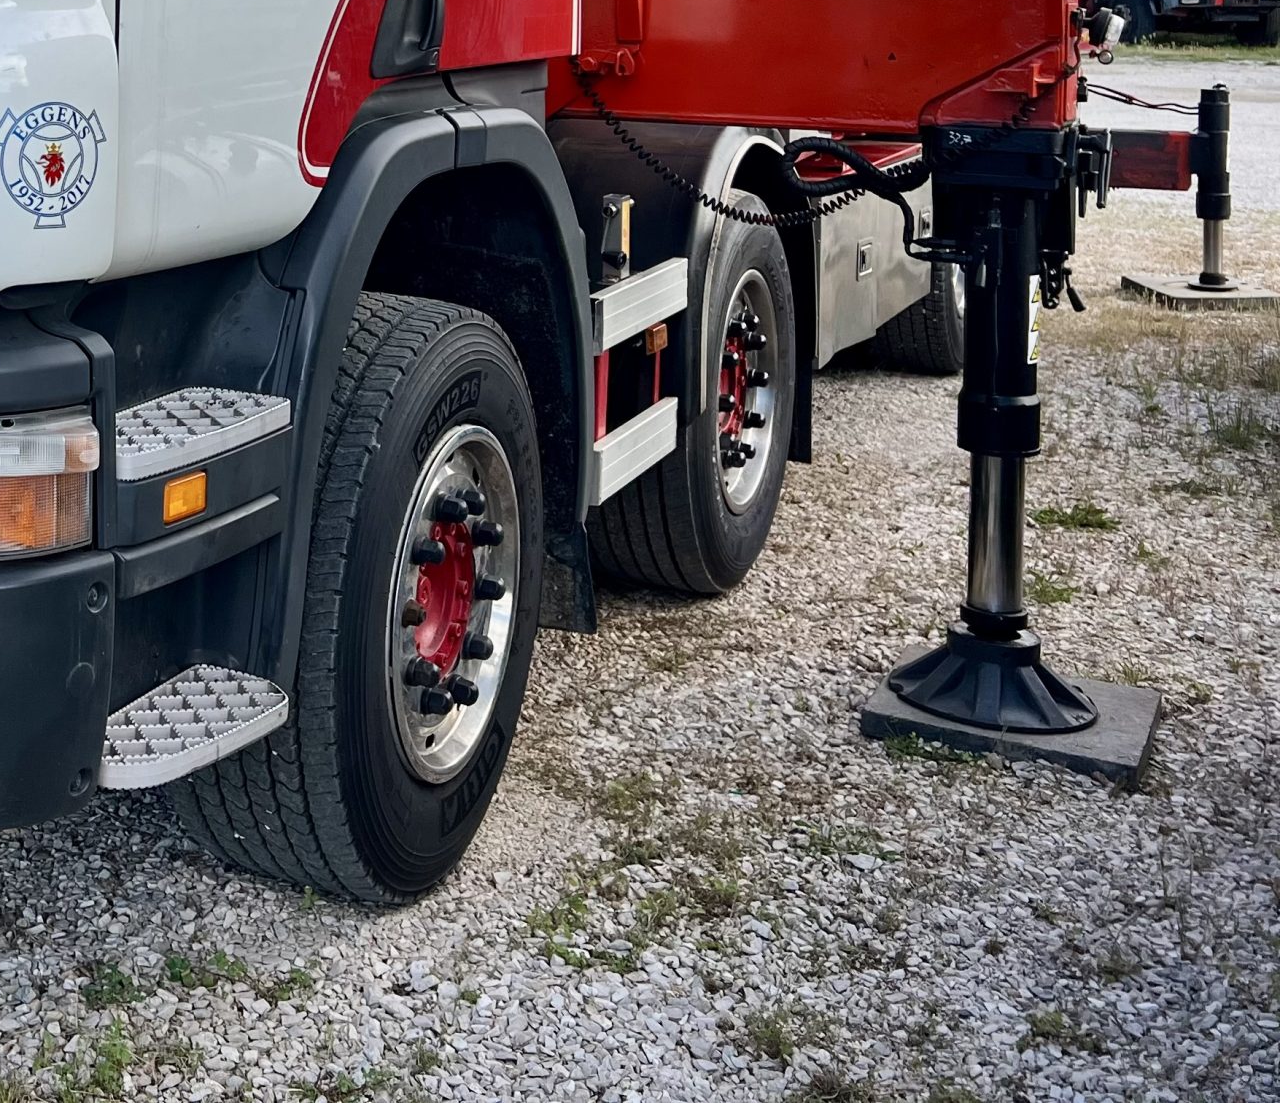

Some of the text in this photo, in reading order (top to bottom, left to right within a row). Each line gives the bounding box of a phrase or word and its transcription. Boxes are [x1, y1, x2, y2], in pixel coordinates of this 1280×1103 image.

[12, 106, 91, 142] EGGENS
[9, 178, 44, 212] 1952
[59, 174, 91, 211] 2017
[417, 377, 480, 462] GSW226
